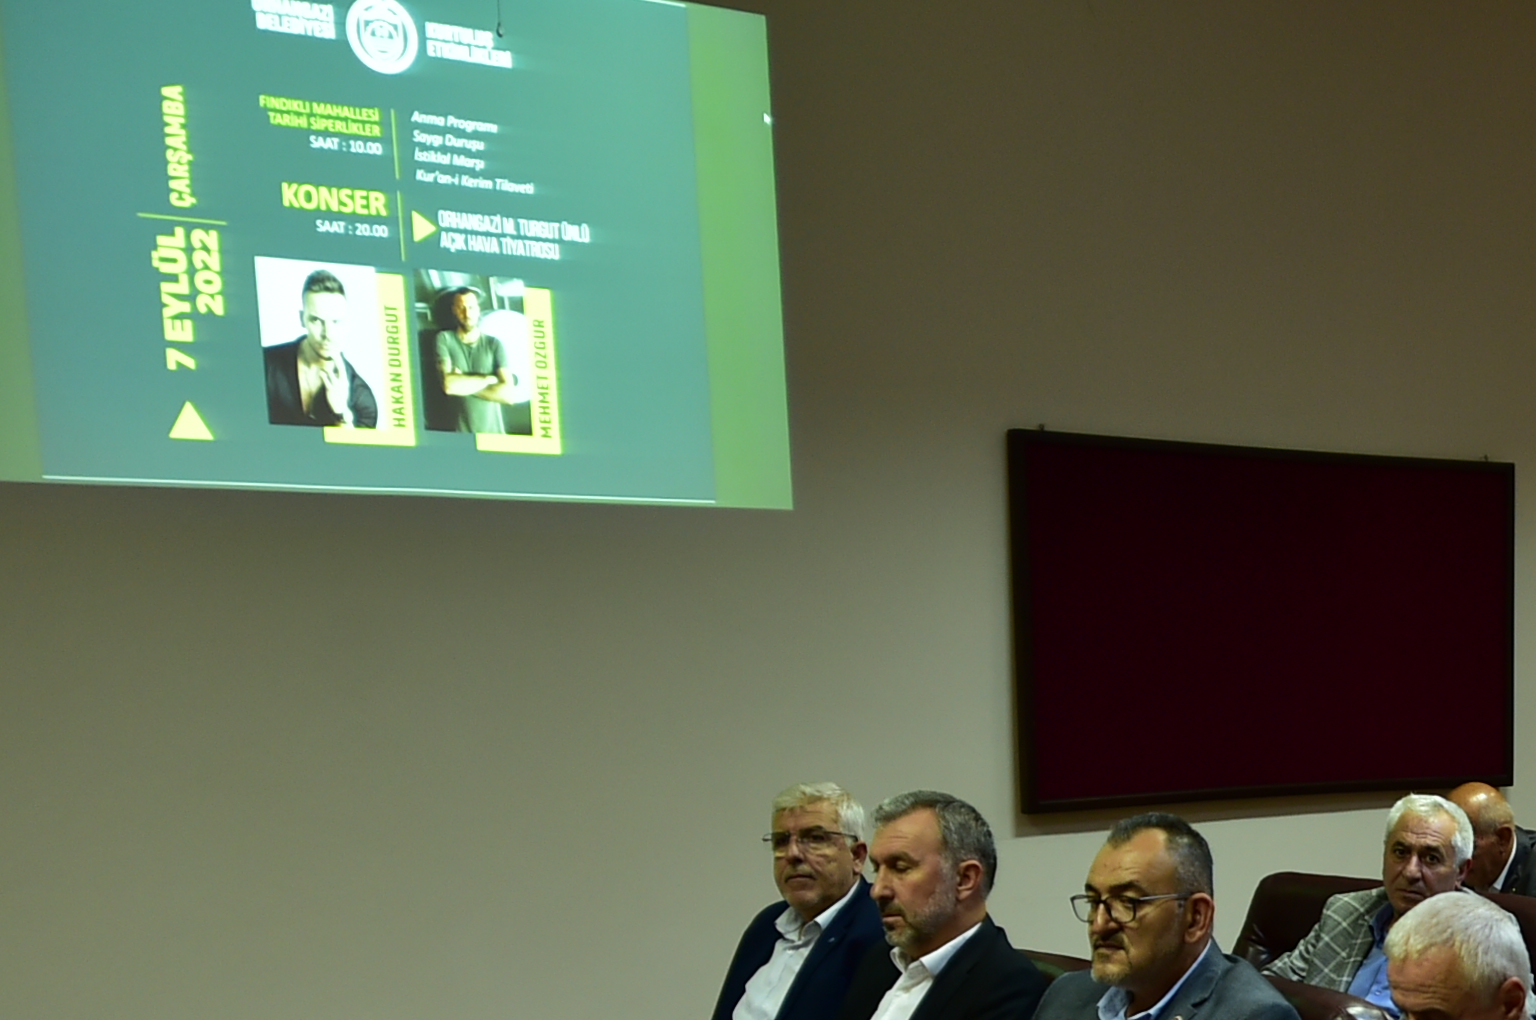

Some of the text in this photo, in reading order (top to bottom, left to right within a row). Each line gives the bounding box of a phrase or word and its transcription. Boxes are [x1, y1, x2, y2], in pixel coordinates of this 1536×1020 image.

[258, 94, 380, 122] FINDIKLI MAHALLESİ
[411, 110, 445, 126] Anma
[267, 111, 382, 137] TARİHİ SİPERLİKLER
[161, 85, 197, 208] ÇARŞAMBA
[309, 135, 340, 151] SAAT
[348, 139, 383, 156] 10.00
[460, 174, 493, 190] Kerim
[281, 181, 388, 217] KONSER
[315, 219, 346, 234] SAAT
[355, 222, 389, 238] 20.00
[438, 209, 502, 233] ORHANGAZİ
[518, 218, 560, 240] TURGUT
[467, 234, 500, 254] HAVA
[500, 235, 561, 261] TİYATROSU
[190, 228, 225, 317] 2022
[151, 226, 197, 371] 7 EYLÜL
[384, 305, 406, 428] HAKAN DURGUT
[536, 375, 553, 439] MEHMET
